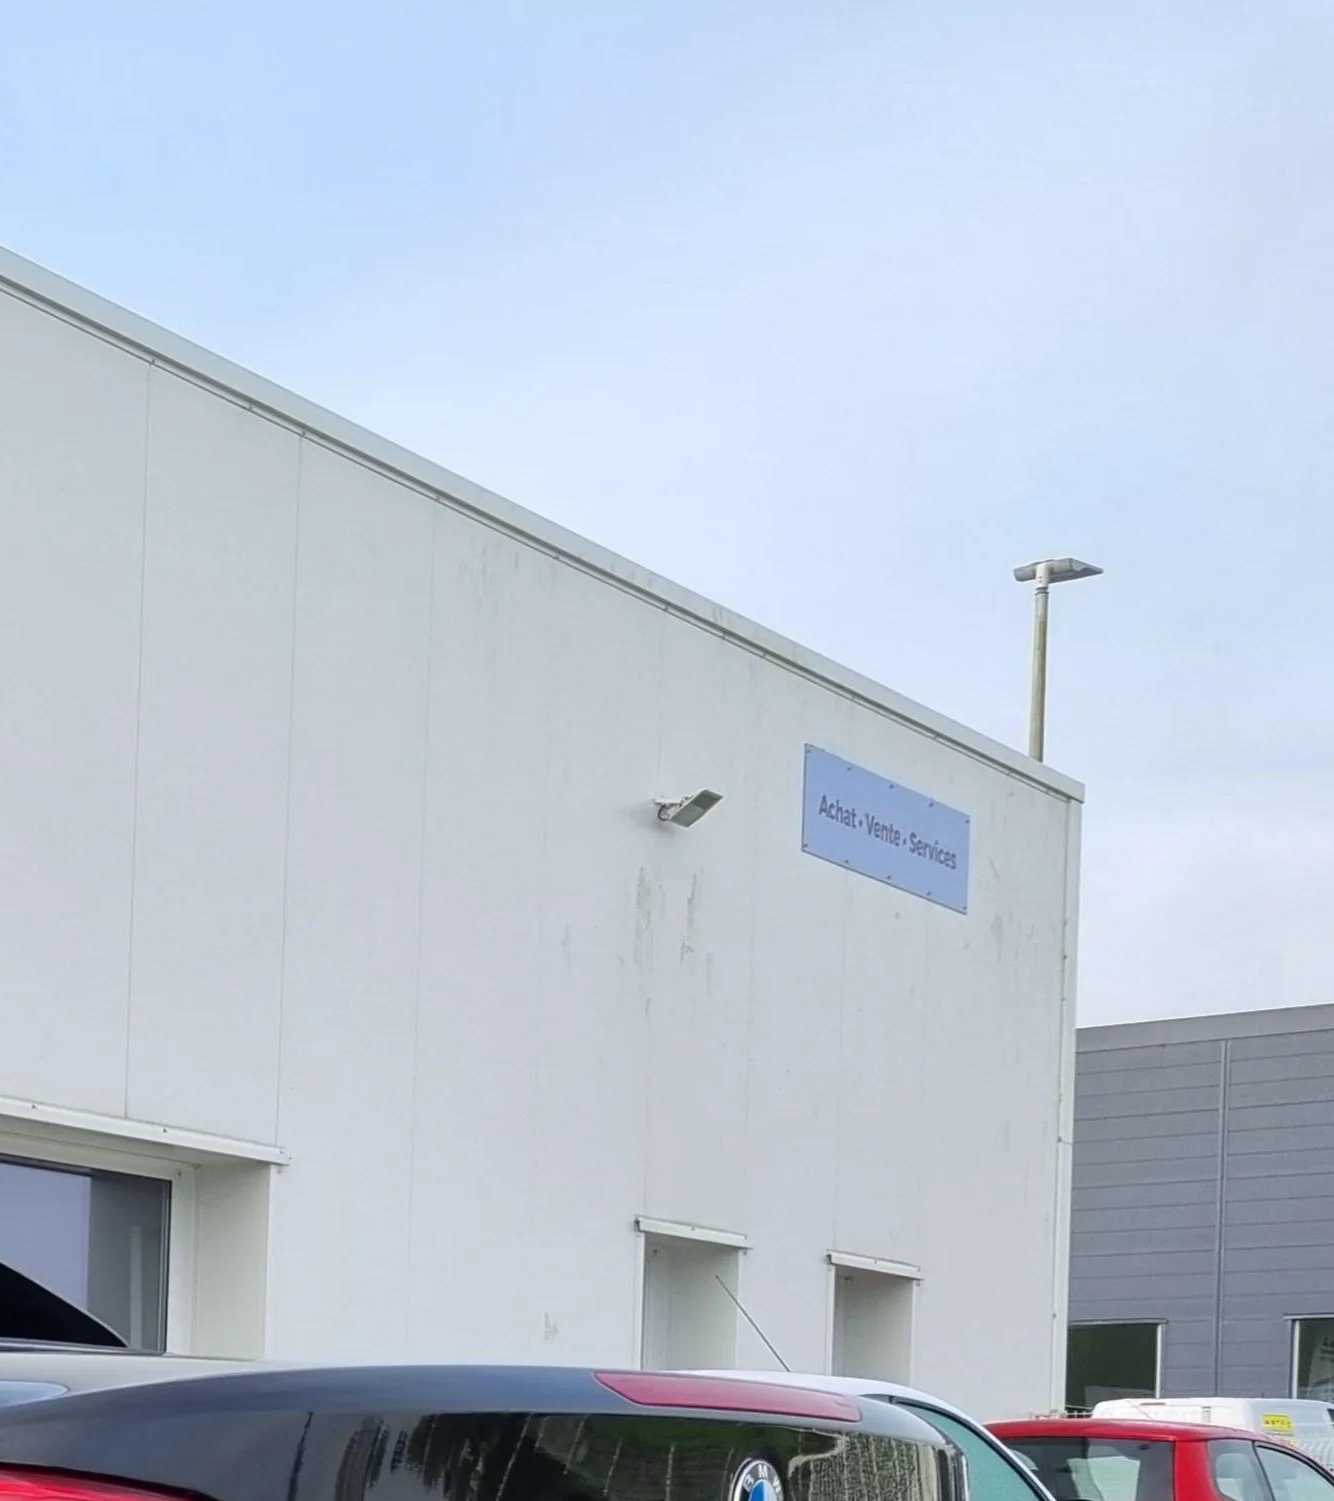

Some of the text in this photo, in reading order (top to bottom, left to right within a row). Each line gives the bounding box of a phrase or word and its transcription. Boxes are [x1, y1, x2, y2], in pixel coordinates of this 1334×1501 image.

[819, 795, 957, 870] Achat Vente Services
